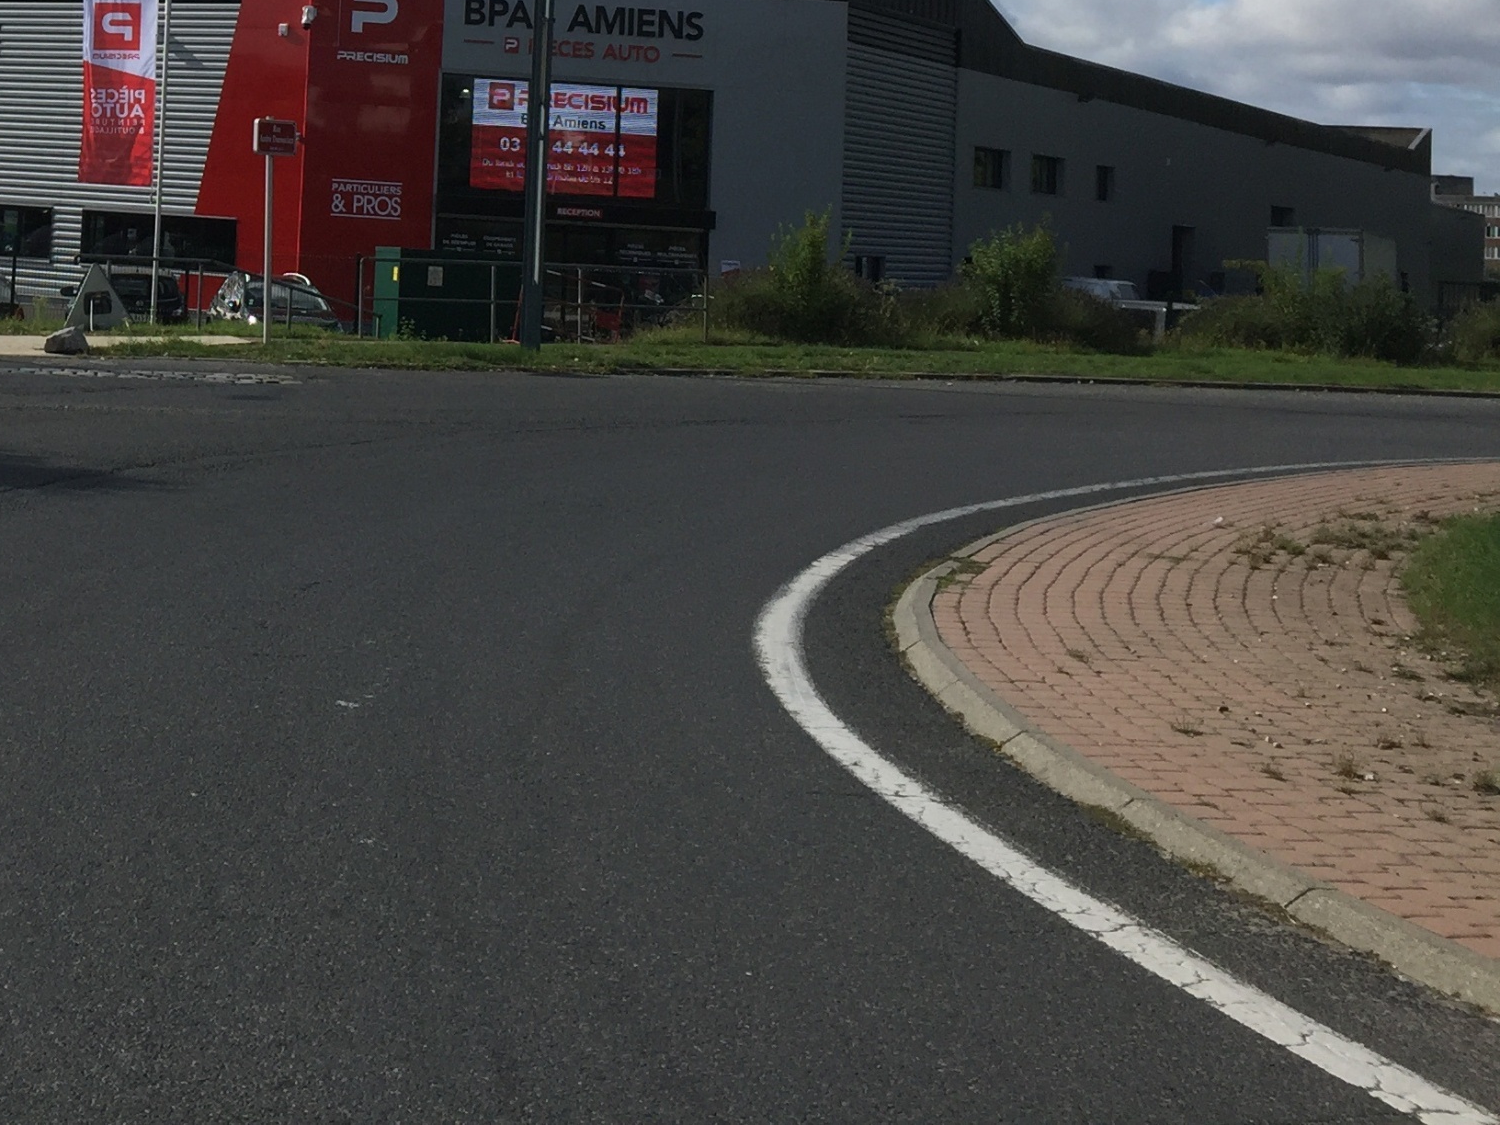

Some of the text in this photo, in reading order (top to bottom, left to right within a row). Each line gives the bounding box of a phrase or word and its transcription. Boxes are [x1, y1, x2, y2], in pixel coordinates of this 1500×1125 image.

[566, 4, 704, 41] AMIENS
[336, 49, 409, 65] PRECISIUM
[602, 42, 661, 64] AUTO
[518, 89, 649, 115] PECISIUM
[553, 114, 606, 131] Amiens
[500, 136, 521, 152] 03
[552, 139, 574, 155] 44
[578, 141, 600, 156] 44
[331, 182, 403, 196] PARTICULIERS
[331, 193, 402, 217] & PROS
[557, 207, 601, 217] RECEPTION
